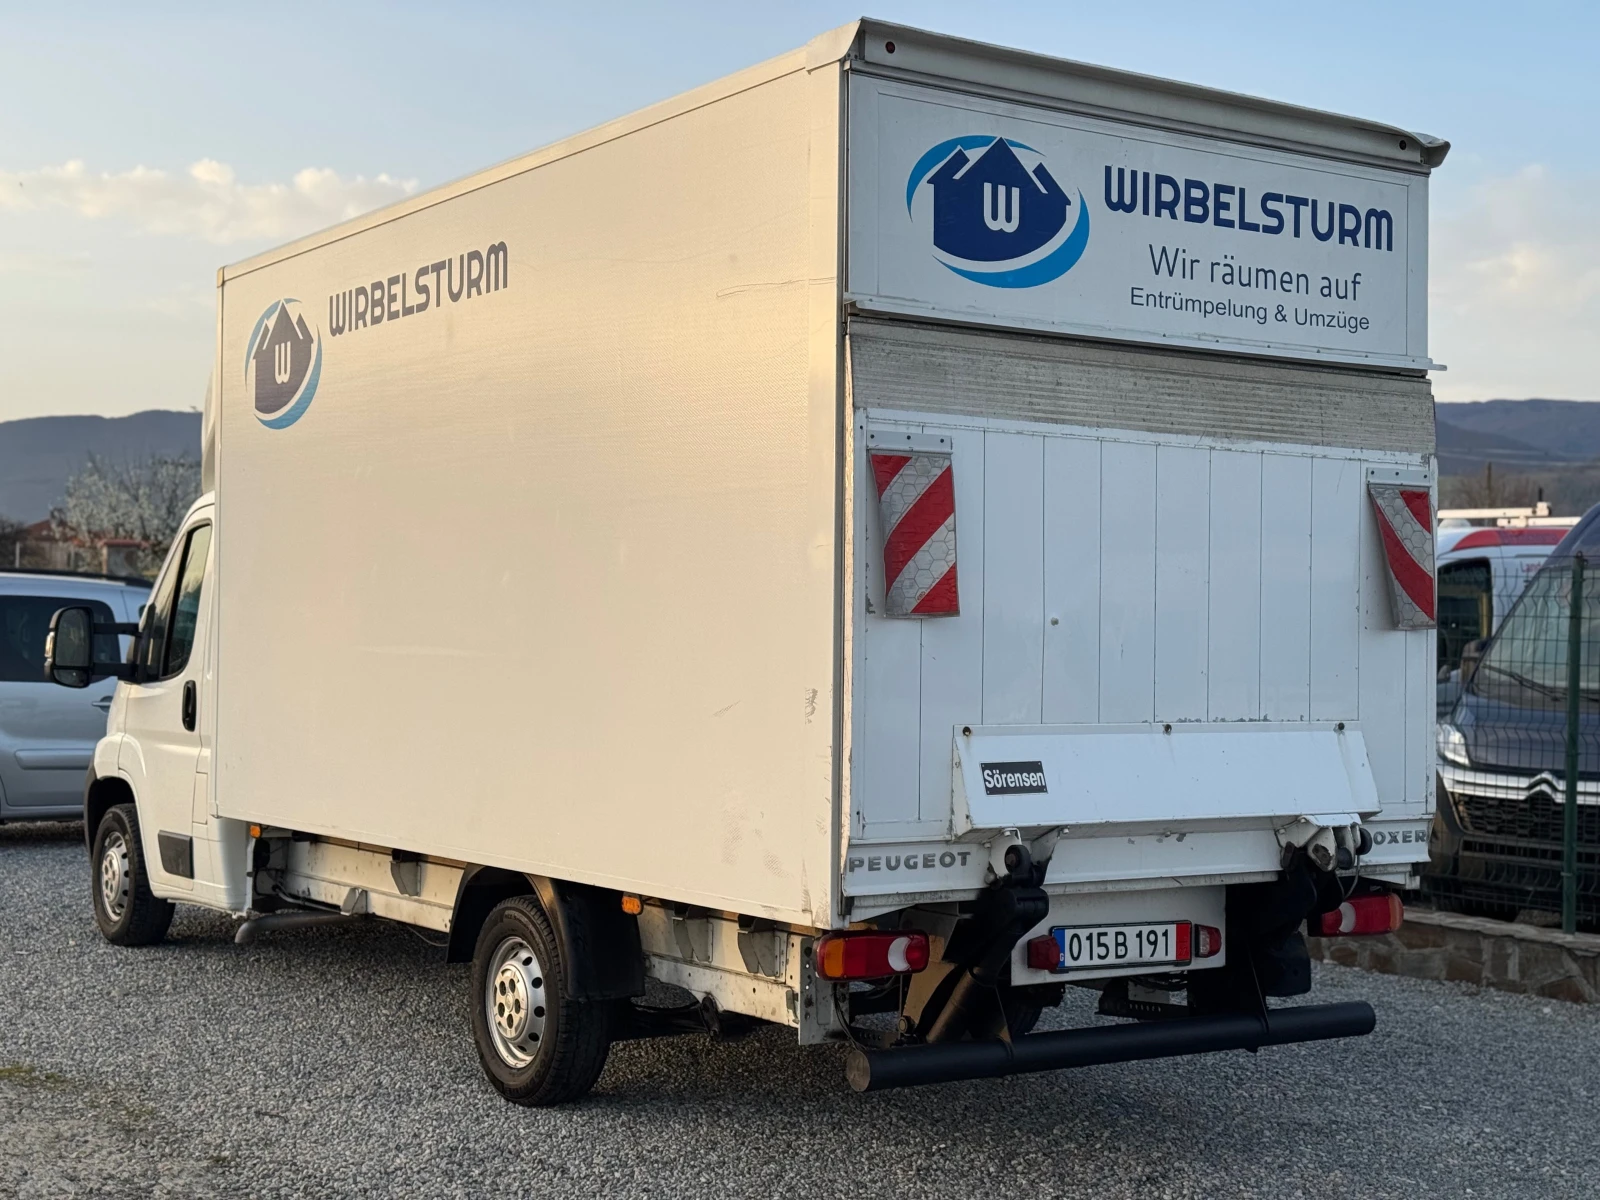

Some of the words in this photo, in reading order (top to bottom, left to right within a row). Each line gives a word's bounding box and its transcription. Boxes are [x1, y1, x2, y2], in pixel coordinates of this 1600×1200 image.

[983, 182, 1020, 233] W
[1104, 165, 1393, 252] WIRBELSTURM
[329, 241, 508, 337] WIRBELSTURM
[1149, 244, 1200, 280] Wir
[1210, 255, 1309, 295] räumen
[1320, 273, 1361, 301] auf
[1131, 287, 1267, 324] Entrümpelung
[1274, 304, 1288, 323] &
[1295, 308, 1370, 333] Umzüge
[274, 341, 291, 385] W
[984, 769, 1046, 788] Sörensen
[1373, 830, 1427, 845] OXER
[849, 851, 971, 872] PEUGEOT
